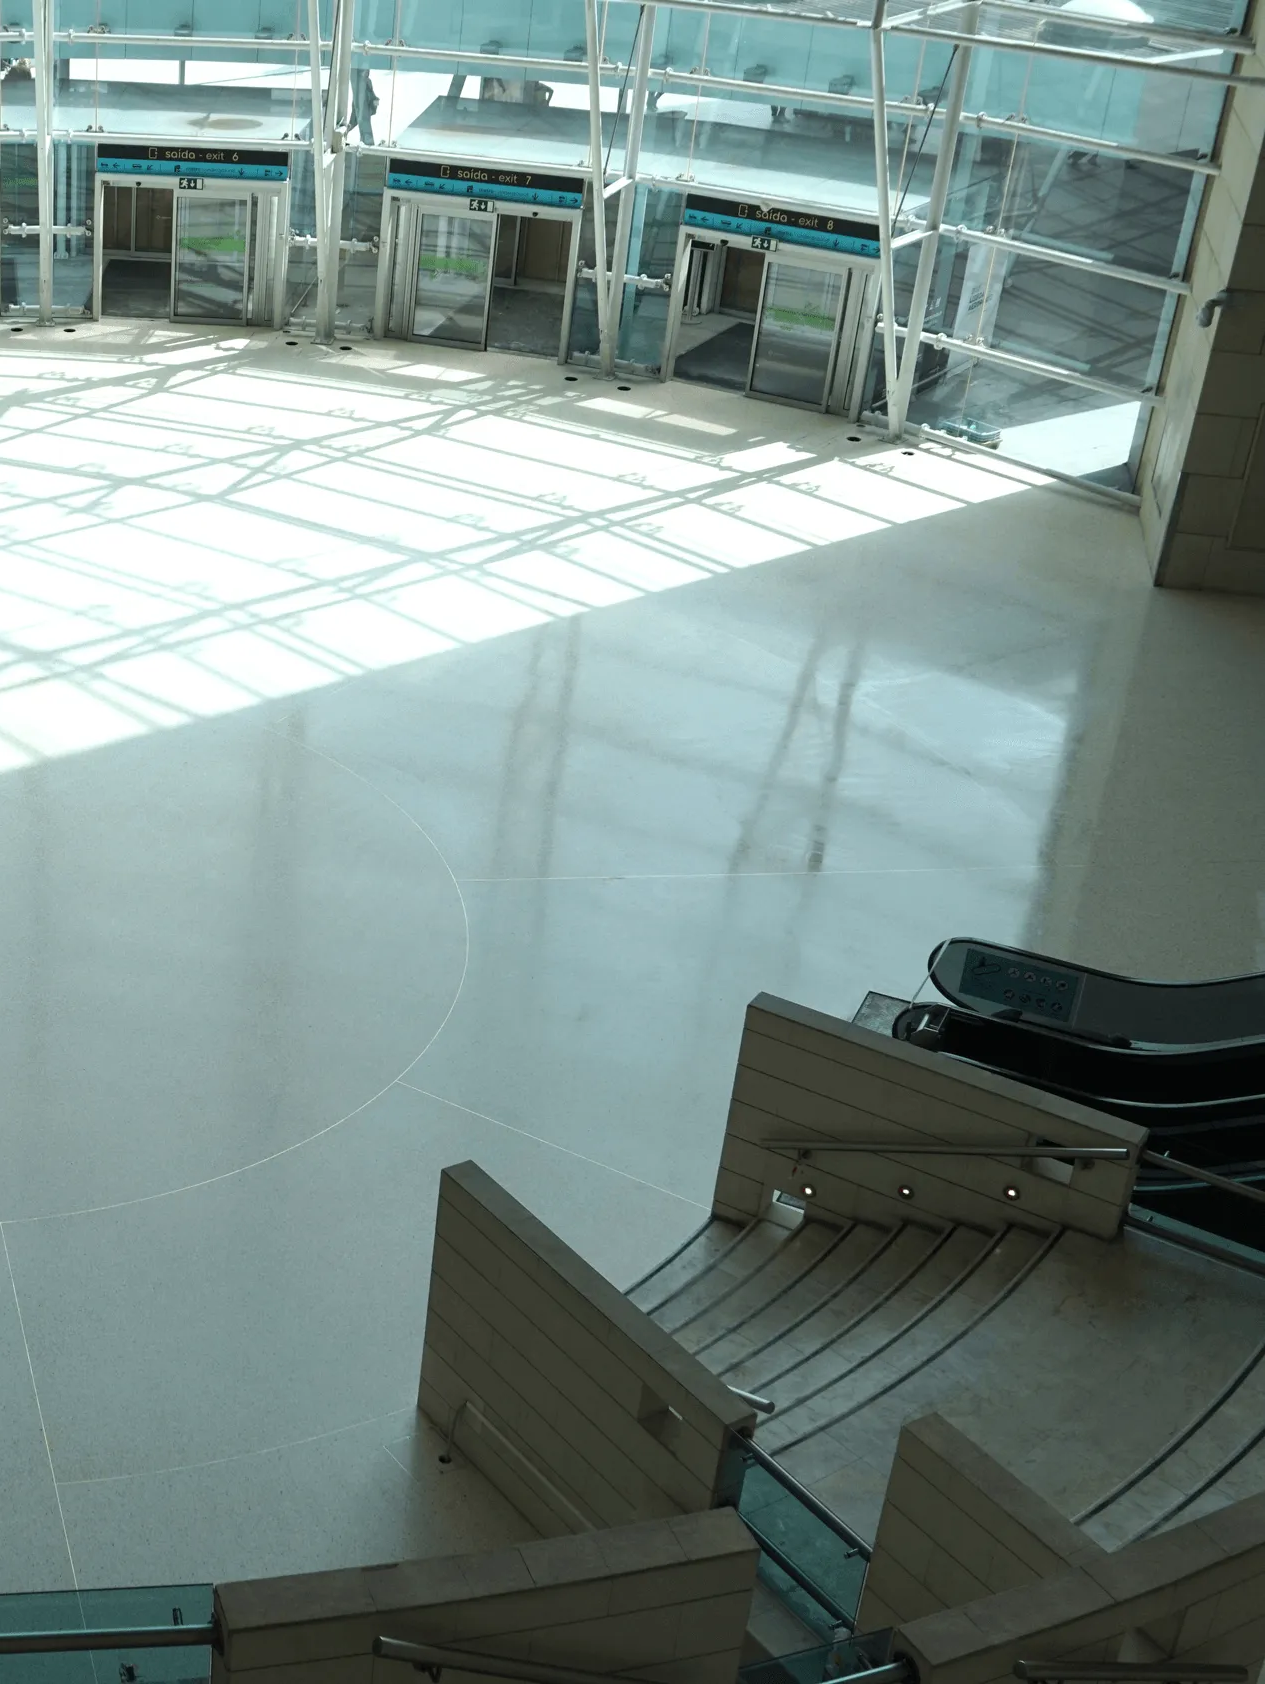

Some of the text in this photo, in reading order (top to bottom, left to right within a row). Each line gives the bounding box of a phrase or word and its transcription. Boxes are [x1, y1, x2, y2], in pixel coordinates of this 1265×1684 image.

[205, 151, 225, 161] exit
[232, 152, 239, 162] 6
[498, 174, 518, 184] exit
[525, 175, 532, 185] 7
[798, 217, 819, 228] exit
[826, 219, 834, 231] 8
